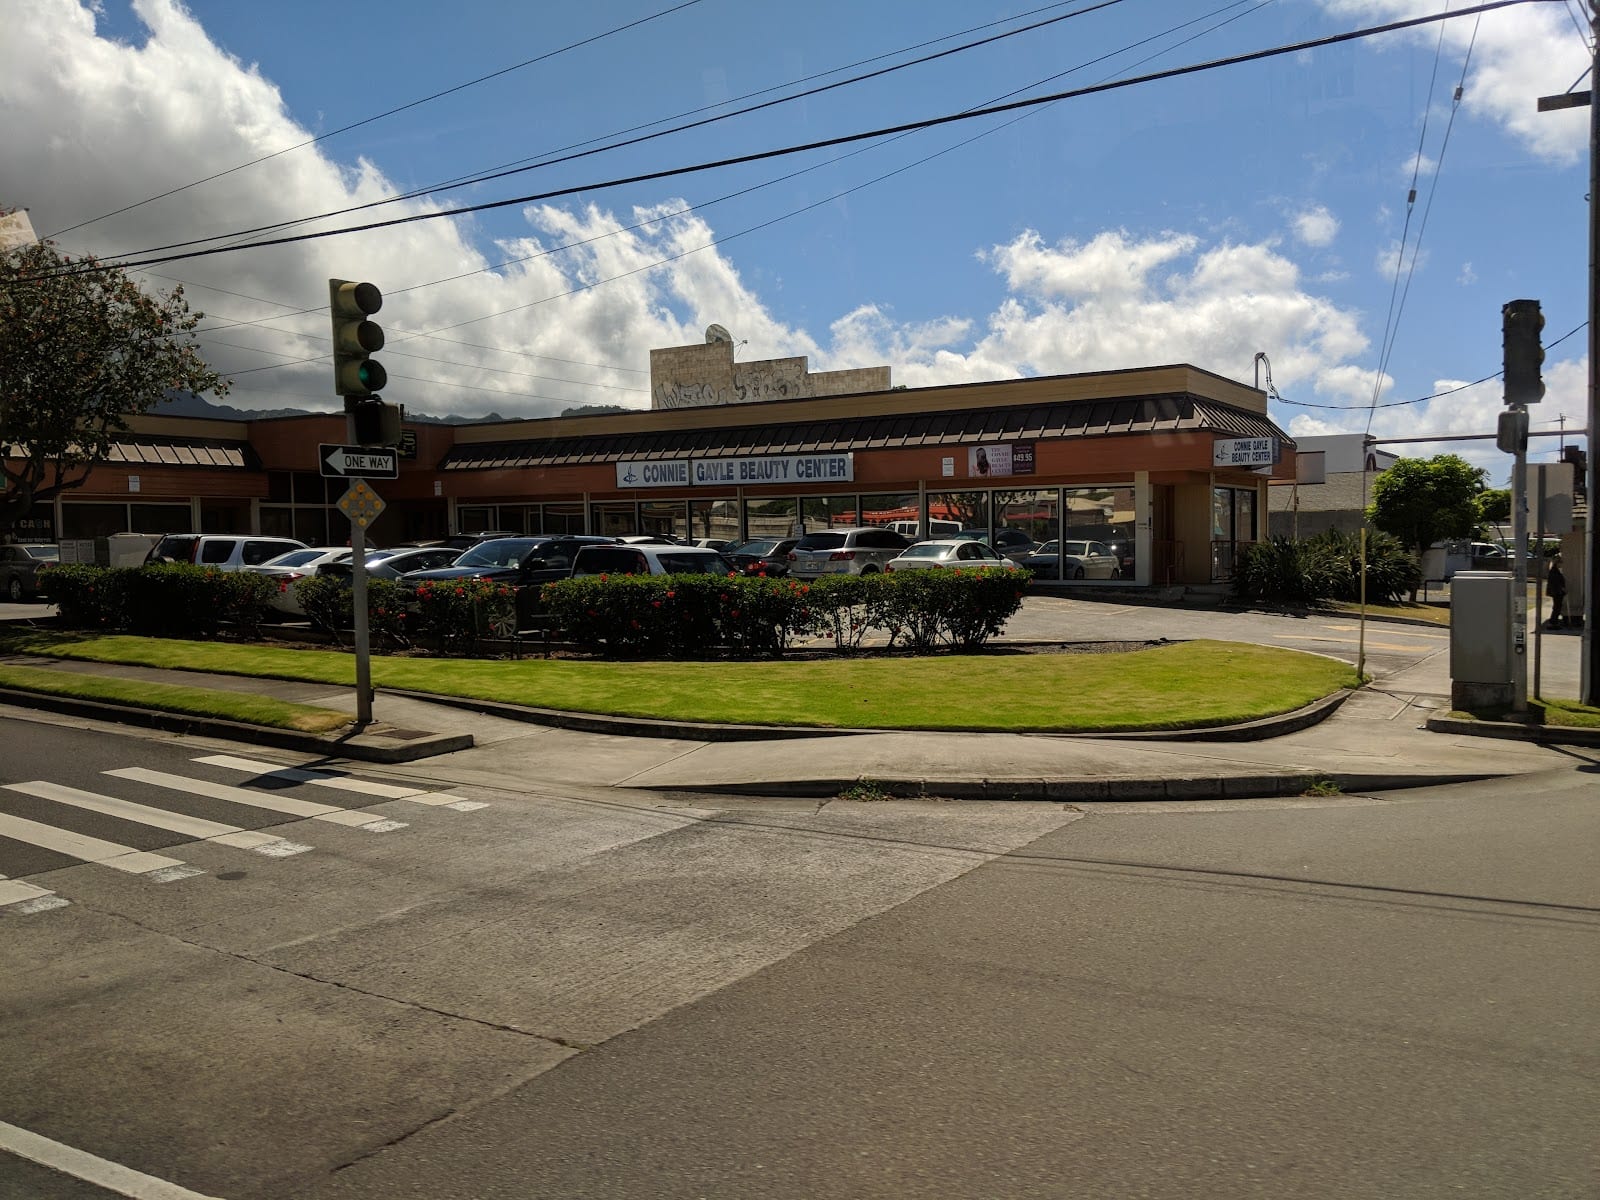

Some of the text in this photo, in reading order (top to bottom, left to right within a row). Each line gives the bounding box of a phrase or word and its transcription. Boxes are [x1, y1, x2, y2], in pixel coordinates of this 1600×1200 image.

[1233, 440, 1268, 452] CONNIE GAYLE
[344, 455, 390, 469] ONE WAY
[1231, 451, 1271, 463] BEAUTY CENTER
[643, 457, 846, 483] CONNIE GAYLE BEAUTY CENTER
